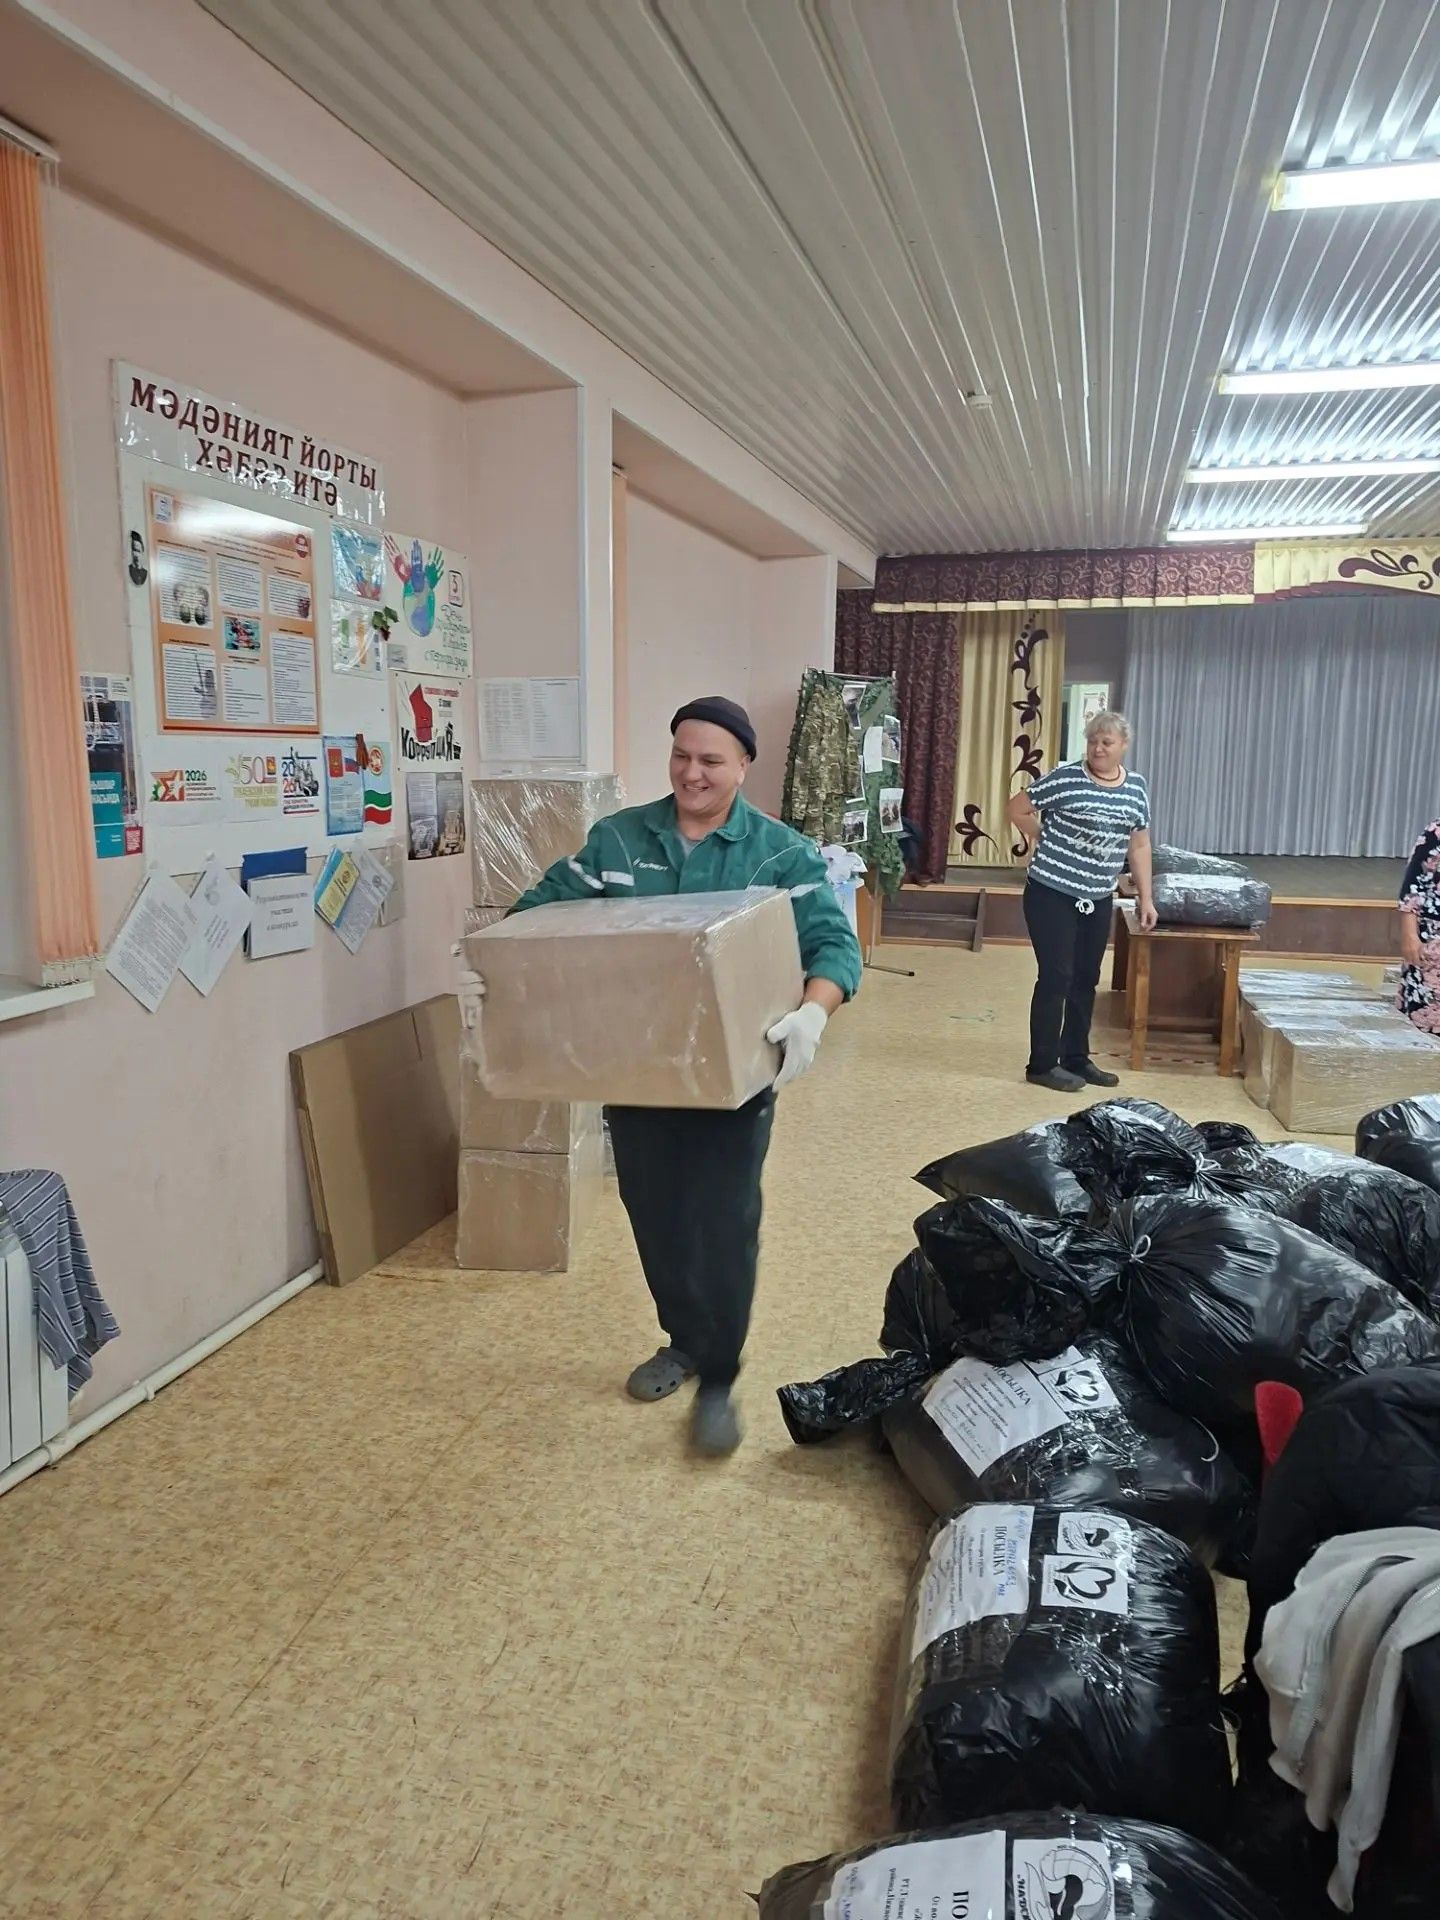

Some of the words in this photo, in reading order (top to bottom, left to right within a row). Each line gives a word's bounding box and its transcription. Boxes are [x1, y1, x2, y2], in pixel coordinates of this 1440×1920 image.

[130, 377, 294, 460] МӘДӘНИЯТ
[300, 435, 377, 491] ЙОРТЫ
[293, 469, 338, 507] ИТӘ
[185, 770, 207, 781] 2026
[281, 761, 295, 776] 20
[283, 778, 296, 793] 26
[993, 1526, 1007, 1576] ПОСЫЛКА
